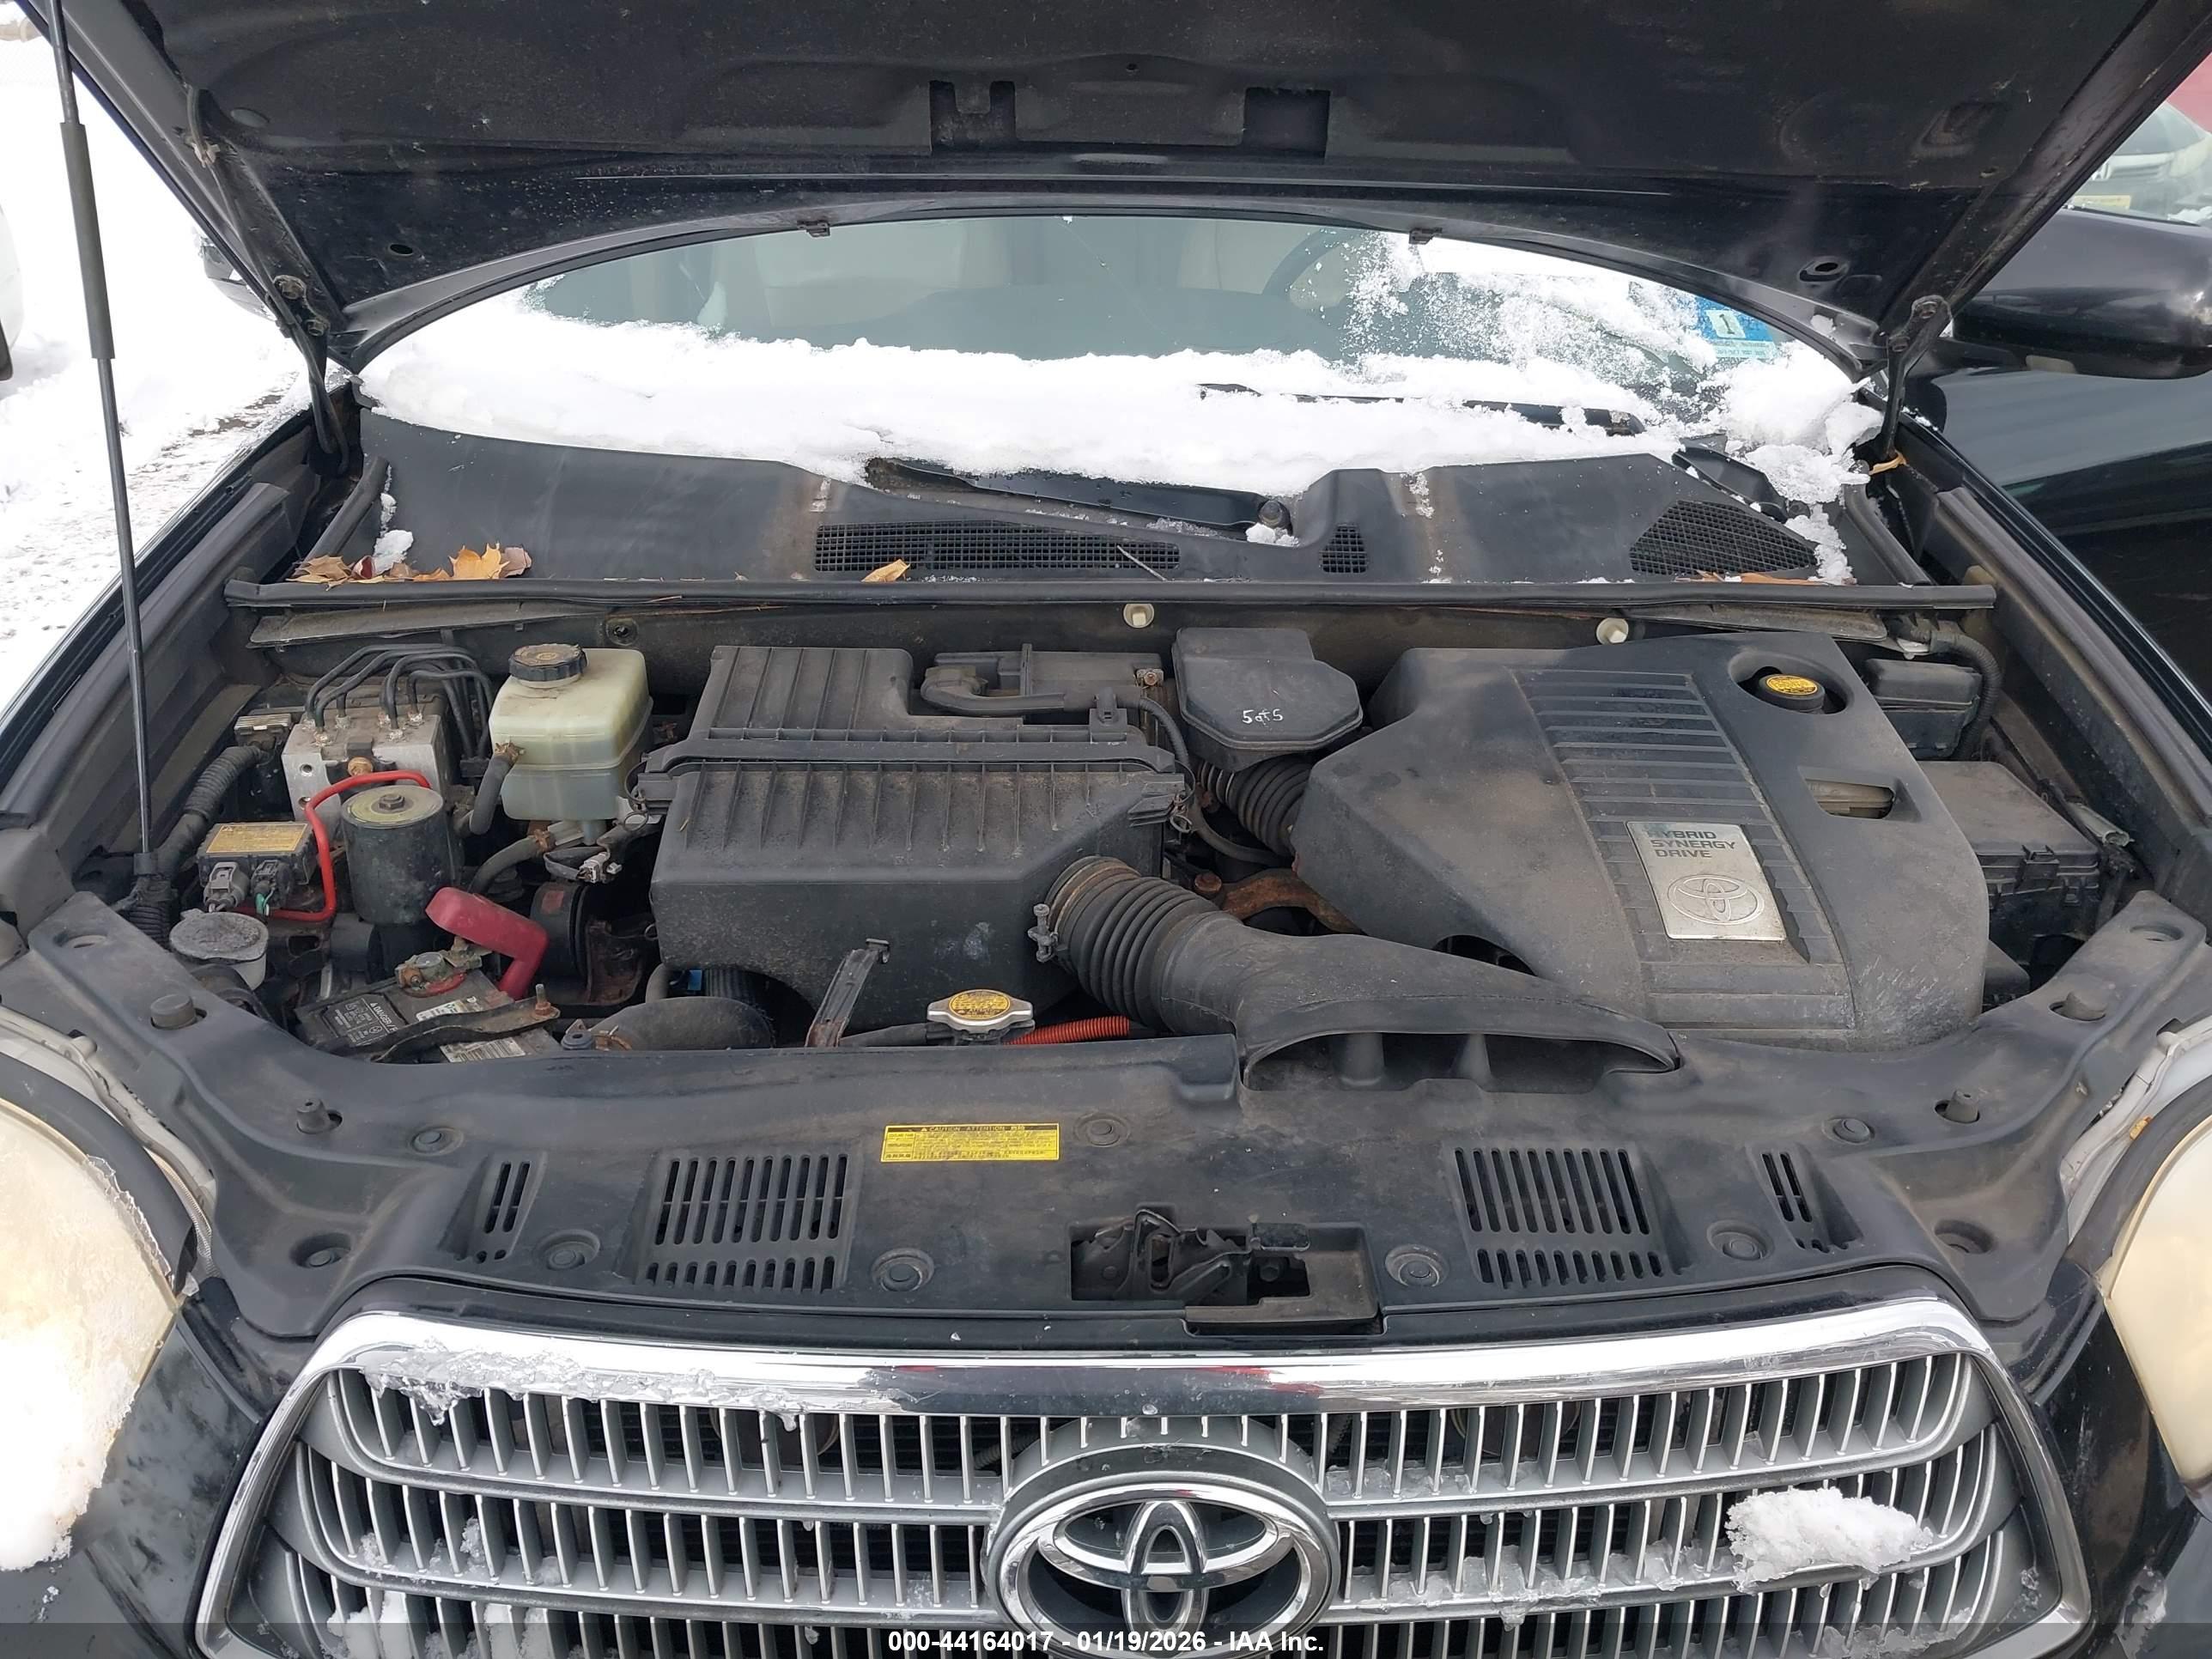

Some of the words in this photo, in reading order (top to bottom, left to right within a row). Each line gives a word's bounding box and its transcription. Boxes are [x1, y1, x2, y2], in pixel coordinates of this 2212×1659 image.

[1719, 313, 1735, 334] 1
[1649, 830, 1717, 839] HYBRID
[1651, 840, 1735, 849] SYNERGY
[1656, 849, 1712, 858] DRIVE
